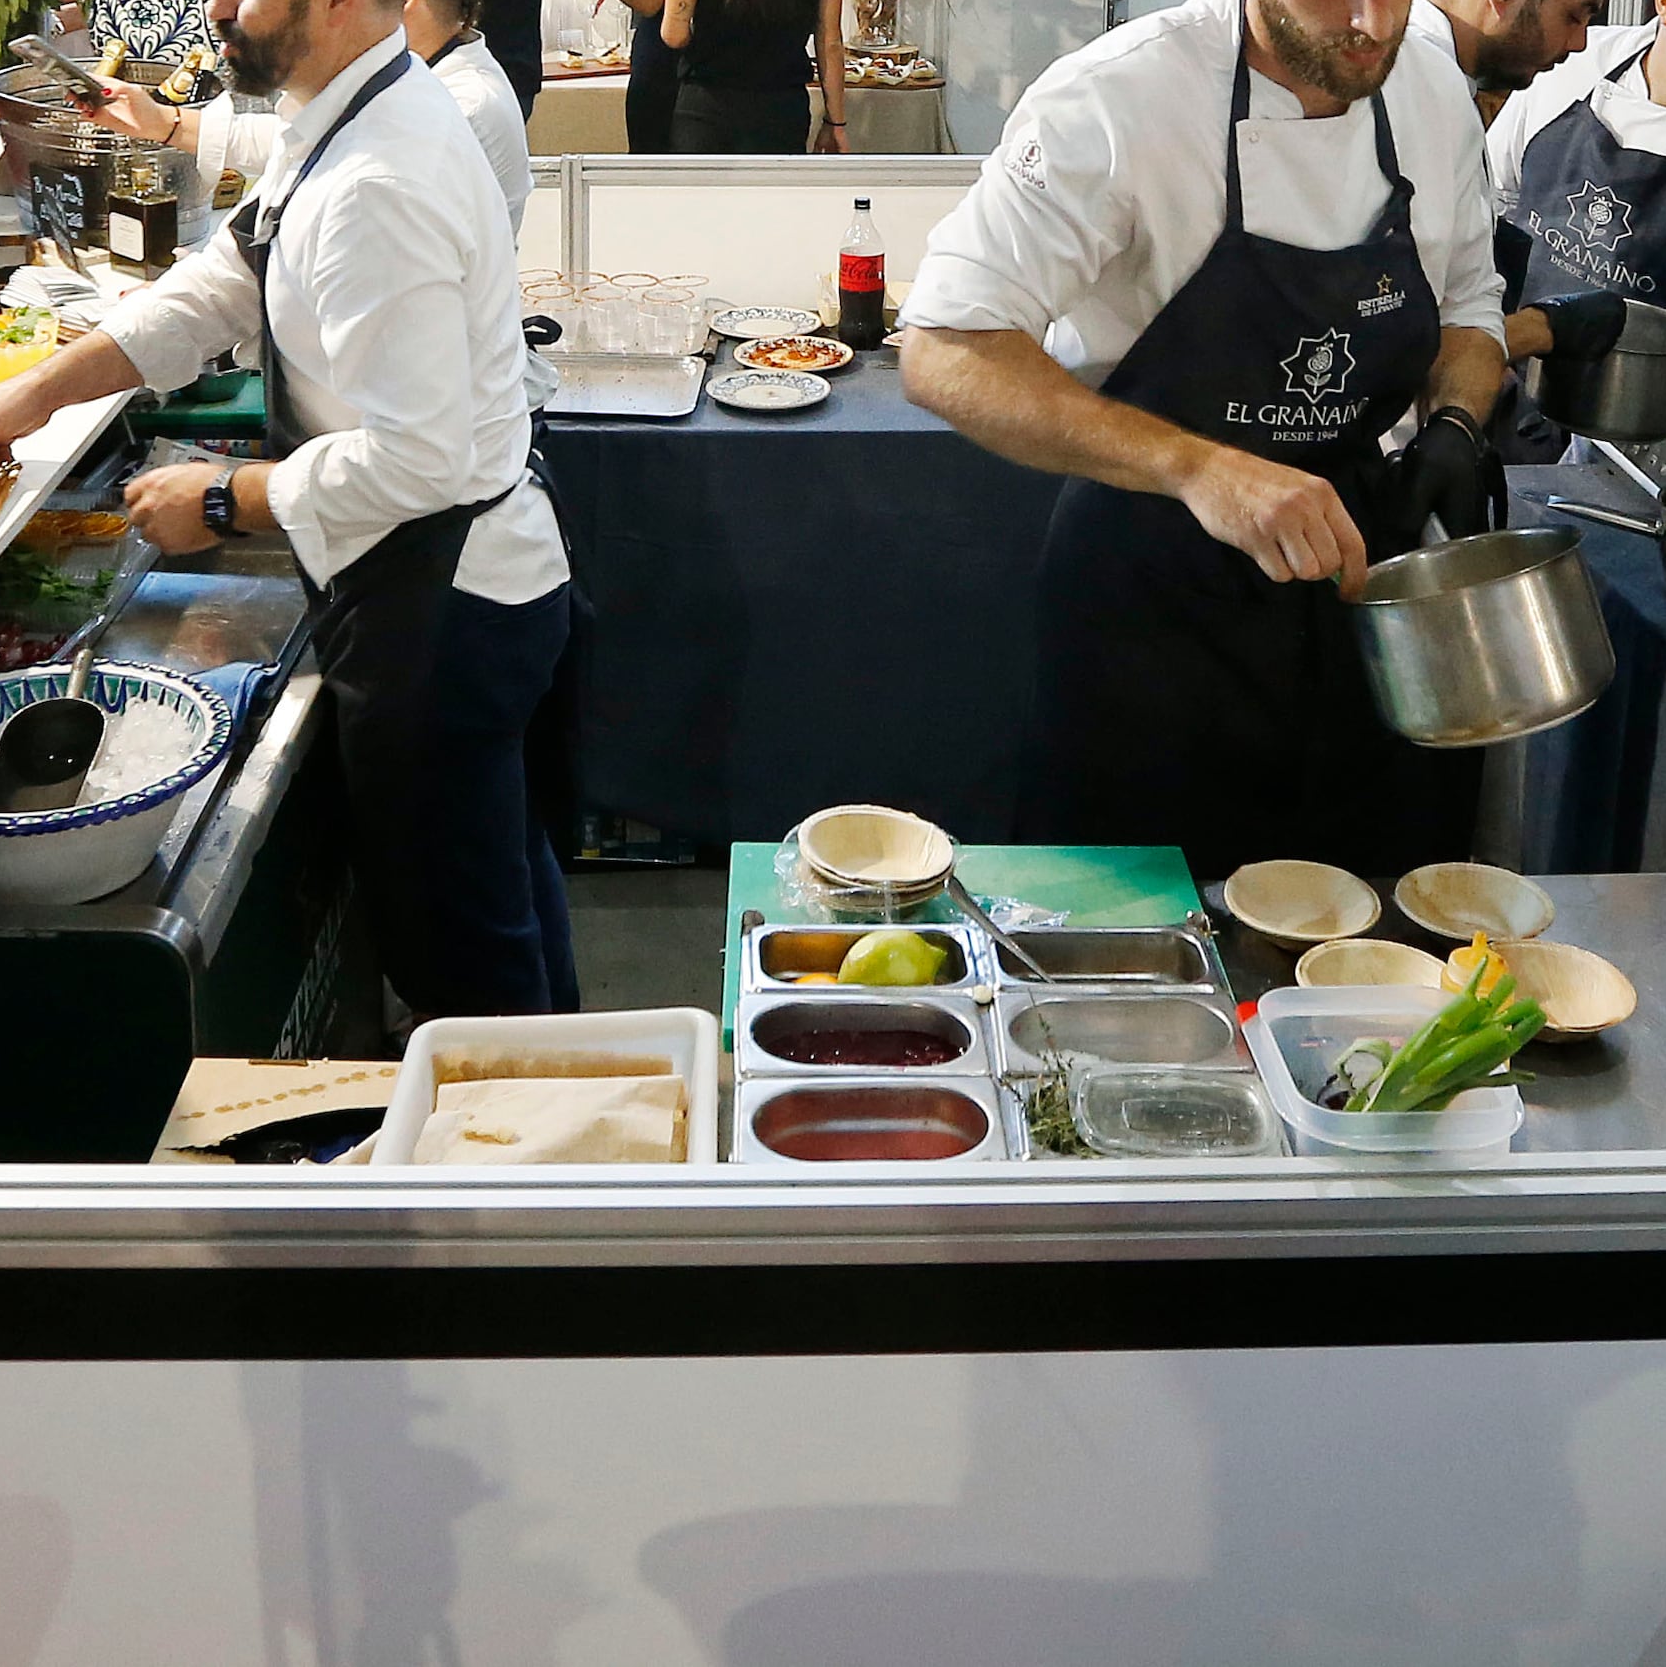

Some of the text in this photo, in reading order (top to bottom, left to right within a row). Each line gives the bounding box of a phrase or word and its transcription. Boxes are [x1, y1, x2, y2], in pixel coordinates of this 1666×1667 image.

[1528, 209, 1656, 293] EL GRANAÍNO
[1549, 254, 1583, 279] DESDE
[1356, 290, 1406, 311] ESTRELLA
[1225, 396, 1370, 427] EL GRANAÍN
[1272, 430, 1314, 442] DESDE
